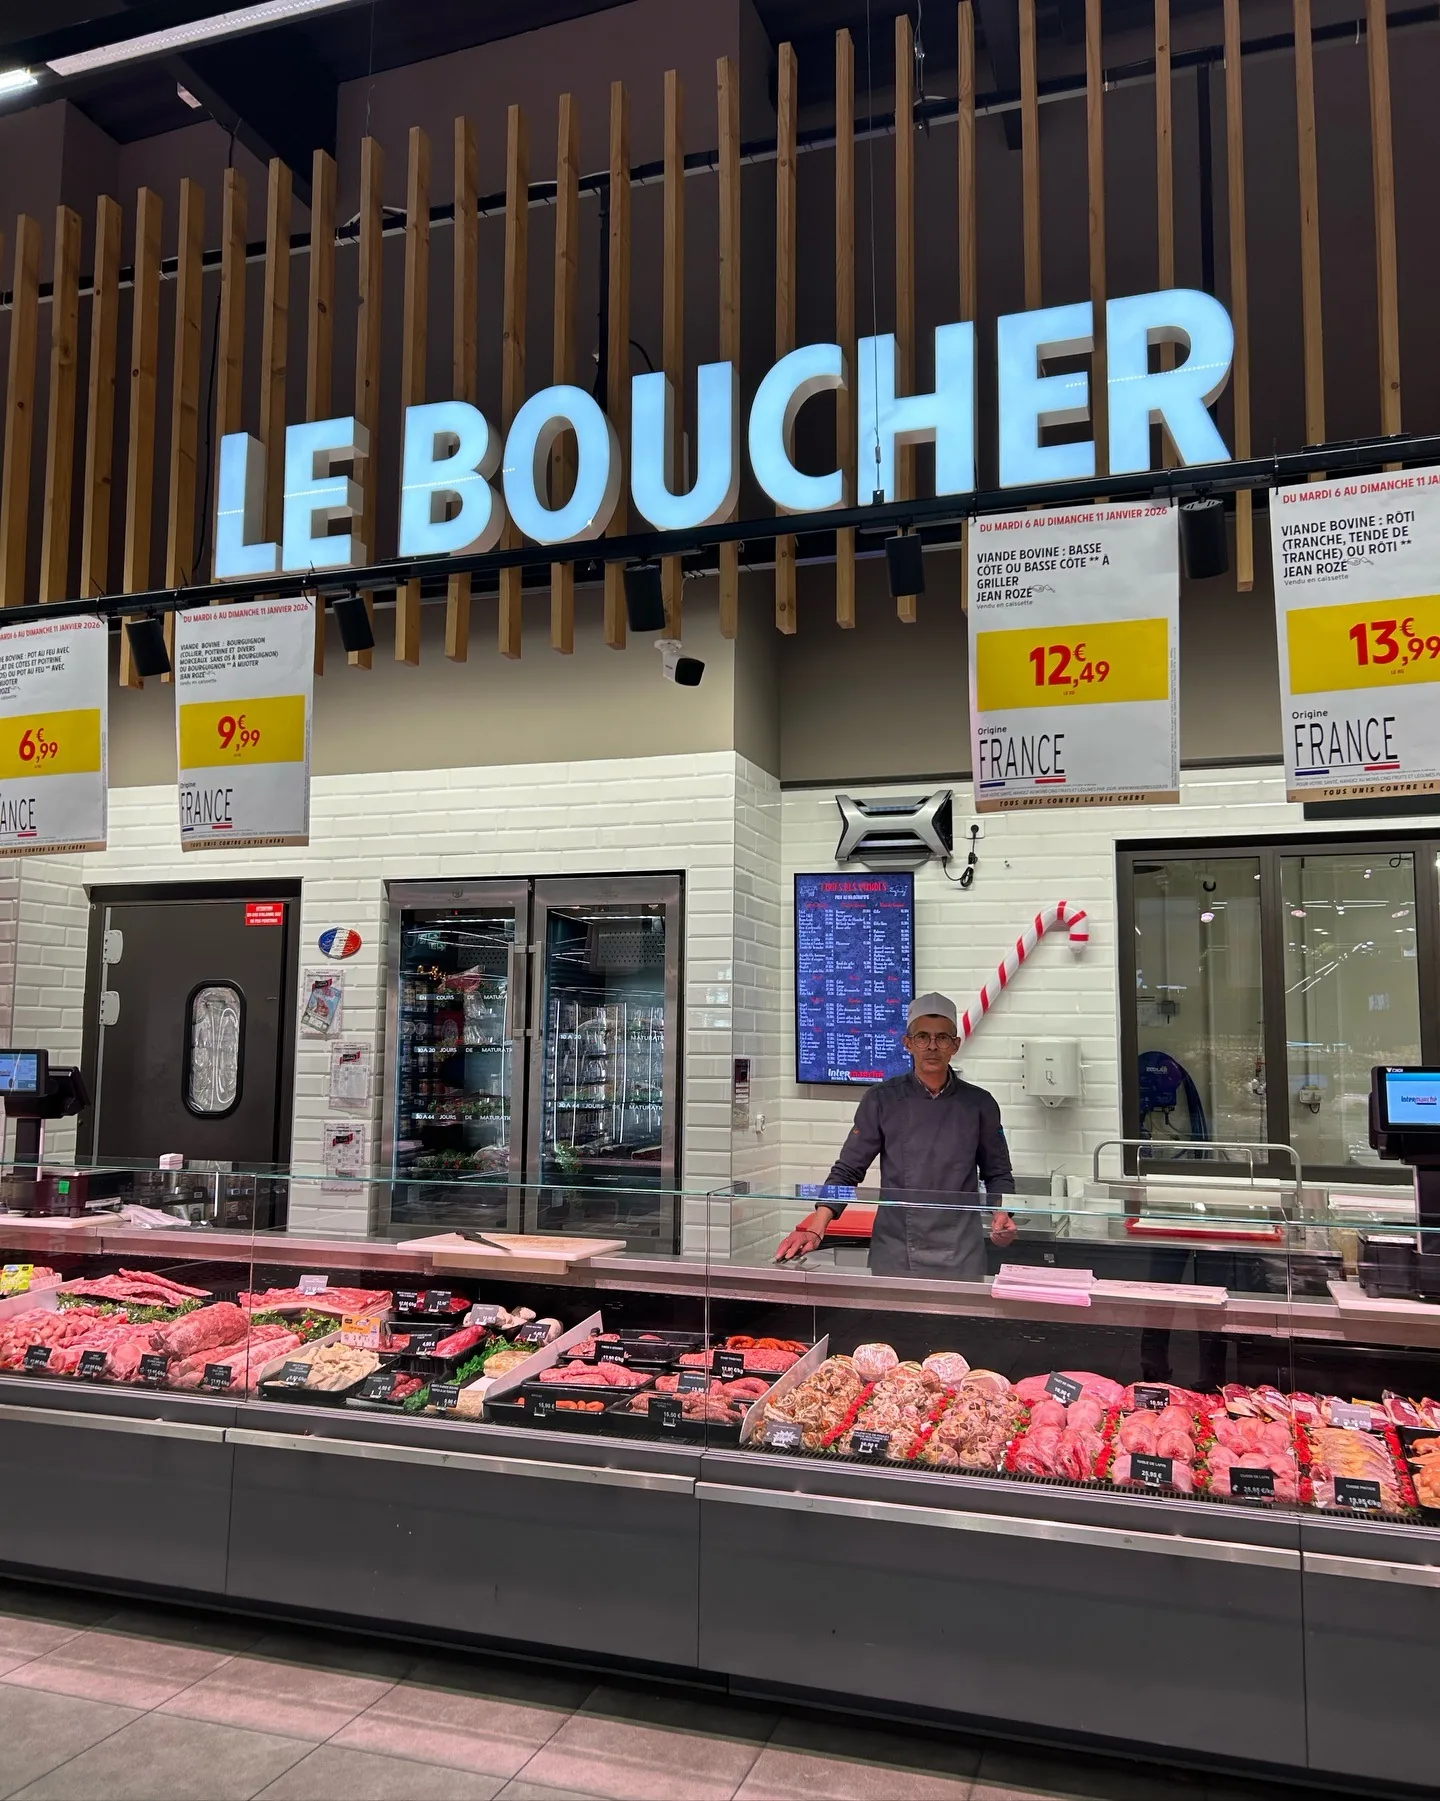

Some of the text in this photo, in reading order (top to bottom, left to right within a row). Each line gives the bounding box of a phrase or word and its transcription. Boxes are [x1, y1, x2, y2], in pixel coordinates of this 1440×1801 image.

[215, 288, 1234, 579] LE BOUCHER
[1283, 477, 1425, 504] DU MARDI 6 AU DIMANCHE 11
[980, 507, 1168, 532] DU MARDI 6 AU DIMANCHE 11 JANVIER 2026
[1282, 510, 1415, 536] VIANDE BOVINE RÔTI
[1282, 526, 1408, 552] (TRANCHE, TENDE DE
[977, 543, 1102, 564] VIANDE BOVINE BASSE
[1282, 541, 1397, 564] TRANCHE) OU RÔTI
[977, 554, 1110, 576] CÔTE OU BASSE CÔTE À
[1284, 559, 1348, 578] JEAN ROZÉ
[977, 576, 1018, 589] GRILLER
[1318, 574, 1349, 582] caissette
[976, 585, 1032, 602] JEAN ROZÉ
[194, 613, 212, 621] MARDI
[228, 608, 260, 618] DIMANCHE
[267, 605, 292, 614] JANVIER
[976, 602, 996, 610] Vendu
[1005, 600, 1034, 608] caissette
[26, 626, 52, 637] DIMANCHE
[60, 622, 82, 632] JANVIER
[202, 641, 220, 649] BOVINE
[226, 637, 266, 646] BOURGUIGNON
[205, 647, 228, 656] POITRINE
[237, 645, 256, 653] DIVERS
[6, 653, 24, 662] BOVINE
[28, 651, 36, 659] POT
[46, 648, 56, 656] FEU
[56, 646, 70, 654] AVEC
[31, 658, 36, 666] ET
[38, 656, 62, 665] POITRINE
[16, 668, 26, 676] POT
[36, 666, 44, 674] FEU
[52, 663, 65, 672] AVEC
[188, 662, 226, 672] BOURGUIGNON
[1292, 709, 1328, 720] Origine
[978, 726, 1007, 736] Origine
[1294, 716, 1398, 767] FRANCE
[980, 734, 1065, 780] FRANCE
[1324, 788, 1347, 796] TOUS
[1380, 784, 1418, 792] CONTRE
[181, 788, 233, 826] FRANCE
